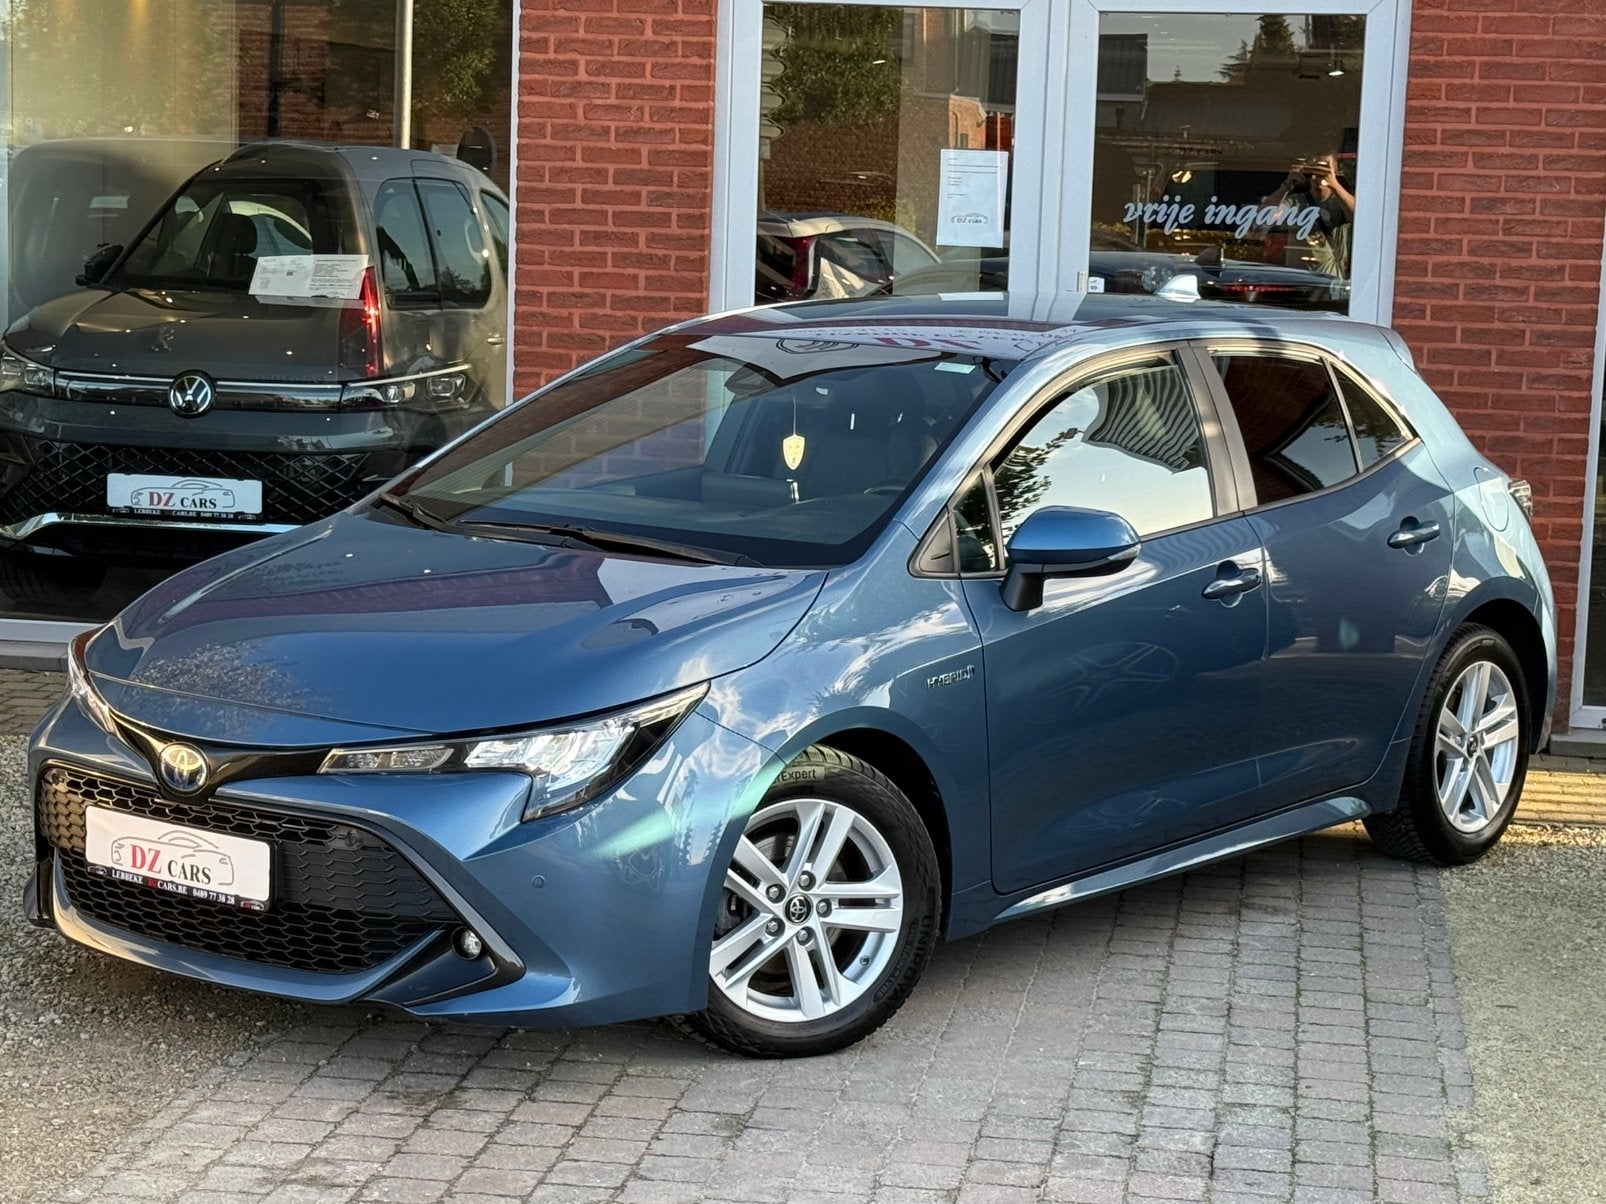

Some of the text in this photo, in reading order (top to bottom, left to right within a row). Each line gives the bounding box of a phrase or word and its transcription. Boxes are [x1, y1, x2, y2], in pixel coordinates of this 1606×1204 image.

[1123, 194, 1321, 240] vrije ingang
[148, 491, 217, 509] DZ CARS
[130, 844, 162, 874] DZ
[167, 859, 212, 885] CARS
[111, 869, 144, 885] LEBBEKE
[192, 888, 208, 900] 0489
[208, 891, 217, 901] 77
[217, 892, 226, 903] 38
[226, 894, 235, 905] 28
